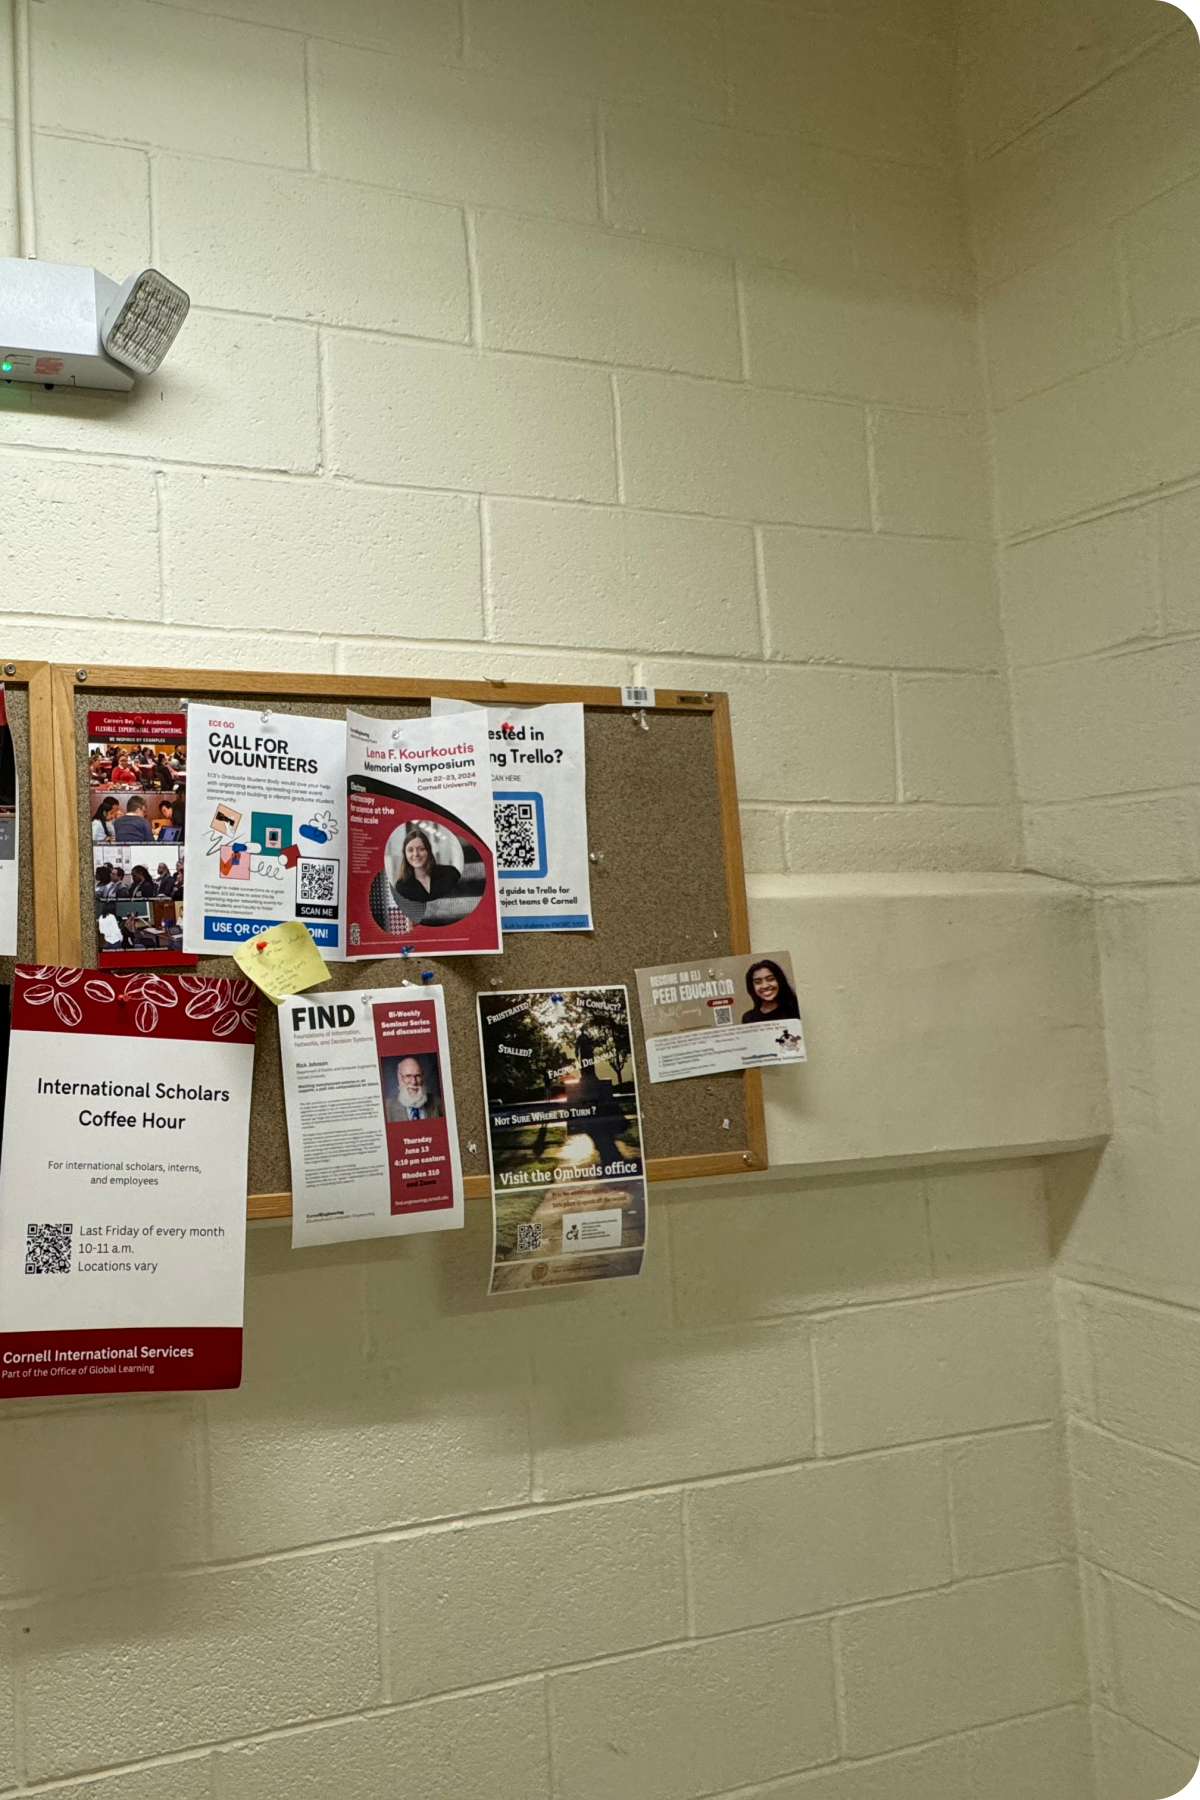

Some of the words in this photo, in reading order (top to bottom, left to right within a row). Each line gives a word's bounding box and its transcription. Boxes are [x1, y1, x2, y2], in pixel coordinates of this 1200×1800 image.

[208, 719, 222, 728] ECE
[222, 721, 235, 729] GO
[488, 726, 526, 741] ested
[530, 726, 544, 741] in
[208, 732, 251, 751] CALL
[255, 737, 289, 755] FOR
[366, 747, 386, 759] Lena
[388, 749, 397, 759] F.
[399, 742, 474, 760] Kourkoutis
[510, 748, 563, 764] Trello?
[208, 749, 318, 774] VOLUNTEERS
[364, 761, 402, 773] Memorial
[404, 758, 475, 775] Symposium
[433, 774, 457, 782] 22-23,
[458, 772, 476, 780] 2024
[417, 783, 442, 792] Cornell
[442, 781, 477, 789] University
[505, 886, 526, 897] guide
[536, 886, 557, 894] Trello
[558, 886, 570, 894] for
[542, 897, 549, 905] @
[550, 896, 578, 905] Cornell
[301, 906, 321, 916] SCAN
[322, 908, 333, 916] ME
[212, 922, 232, 933] USE
[234, 924, 250, 936] QR
[252, 925, 274, 935] CO
[307, 928, 329, 939] OIN!
[652, 987, 677, 1005] PEER
[679, 979, 734, 1001] EDUCATOR
[292, 1004, 355, 1031] FIND
[388, 1010, 421, 1018] Bi-Weekly
[381, 1021, 409, 1029] Seminar
[396, 1027, 431, 1036] discussion
[38, 1078, 150, 1098] International
[155, 1083, 230, 1102] Scholars
[79, 1109, 137, 1128] Coffee
[143, 1112, 186, 1129] Hour
[403, 1136, 432, 1145] Thursday
[48, 1160, 64, 1170] For
[65, 1161, 124, 1171] international
[125, 1162, 166, 1173] scholars,
[168, 1164, 202, 1174] interns,
[499, 1171, 529, 1185] Visit
[531, 1169, 551, 1182] the
[554, 1163, 603, 1183] Ombuds
[604, 1161, 637, 1175] office
[90, 1175, 108, 1185] and
[109, 1176, 159, 1187] employees
[80, 1225, 103, 1236] Last
[105, 1225, 140, 1239] Friday
[142, 1225, 154, 1236] of
[156, 1228, 187, 1239] every
[189, 1226, 225, 1237] month
[78, 1243, 109, 1254] 10-11
[111, 1245, 134, 1254] a.m.
[78, 1260, 131, 1272] Locations
[134, 1262, 158, 1274] vary
[3, 1349, 51, 1364] Cornell
[55, 1346, 138, 1362] International
[141, 1345, 194, 1358] Services
[1, 1369, 20, 1379] Part
[22, 1368, 32, 1378] of
[33, 1368, 49, 1377] the
[50, 1366, 77, 1376] Office
[78, 1365, 88, 1375] of
[89, 1364, 116, 1374] Global
[118, 1364, 155, 1374] Learning
